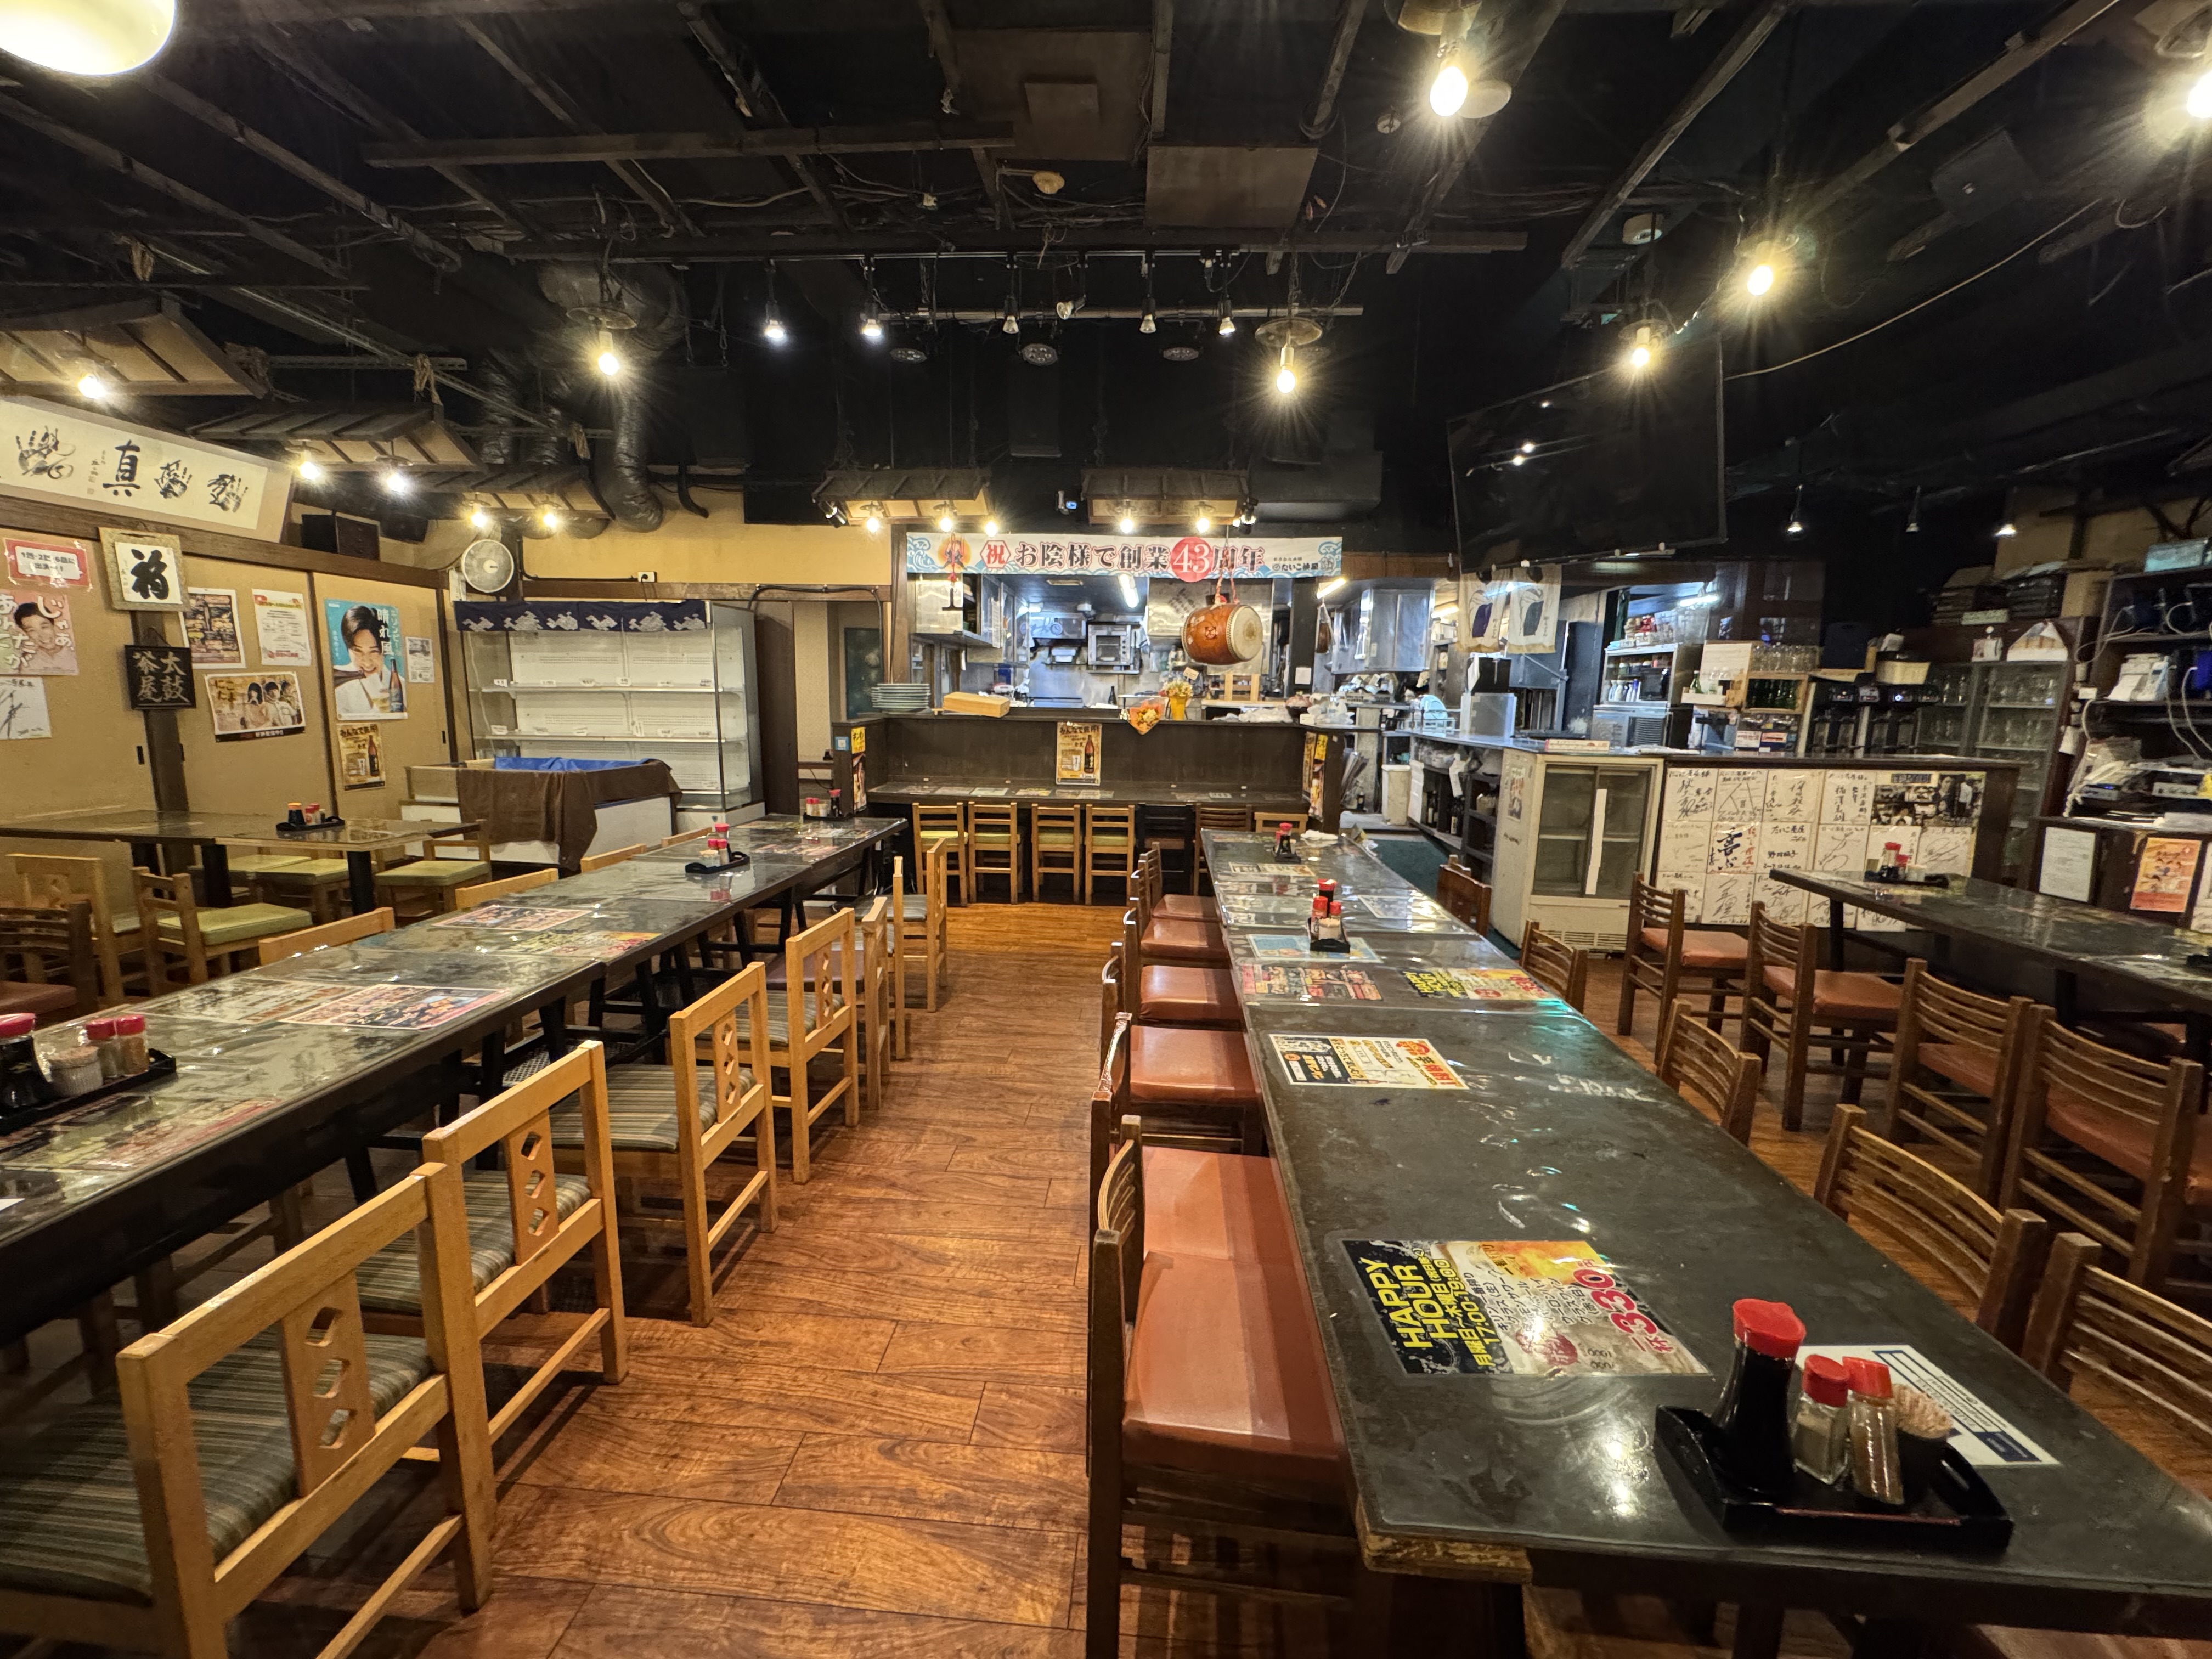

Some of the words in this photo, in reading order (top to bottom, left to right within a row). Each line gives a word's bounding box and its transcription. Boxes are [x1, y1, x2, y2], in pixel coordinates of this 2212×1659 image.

[103, 439, 141, 497] 真
[986, 544, 1005, 565] 祝
[377, 608, 394, 657] 晴れ風
[132, 651, 163, 703] 茶屋
[160, 651, 190, 703] 太鼓
[1359, 1257, 1434, 1347] HAPPY
[1391, 1265, 1459, 1338] HOUR
[1432, 1259, 1503, 1344] 17:00-19:00
[1530, 1278, 1576, 1324] ウーロンハイ
[1546, 1277, 1594, 1323] グラスワイン
[1573, 1268, 1660, 1335] 330
